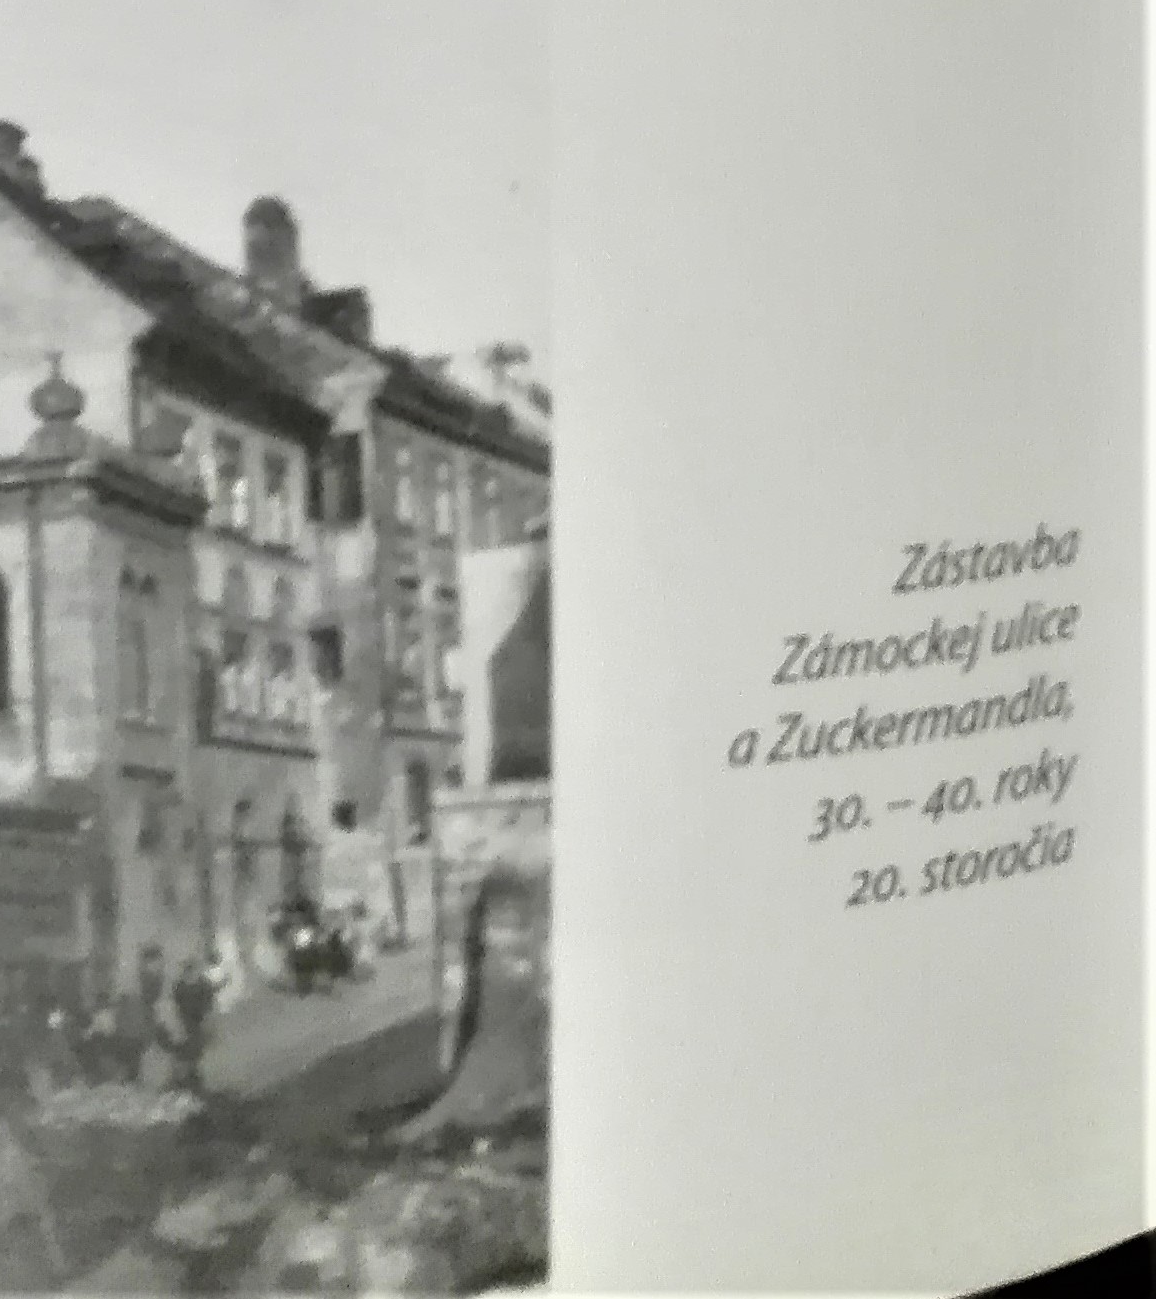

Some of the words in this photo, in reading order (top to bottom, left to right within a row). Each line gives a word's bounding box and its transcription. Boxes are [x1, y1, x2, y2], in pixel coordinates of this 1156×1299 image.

[892, 521, 1082, 595] Zástavba
[772, 611, 988, 685] Zámockej
[991, 600, 1083, 655] ulice
[728, 727, 760, 769] a
[766, 675, 1075, 767] Zuckermandla,
[806, 794, 872, 842] 30.
[922, 775, 983, 823] 40.
[994, 748, 1081, 806] roky
[845, 863, 908, 910] 20.
[921, 820, 1076, 895] storočia
